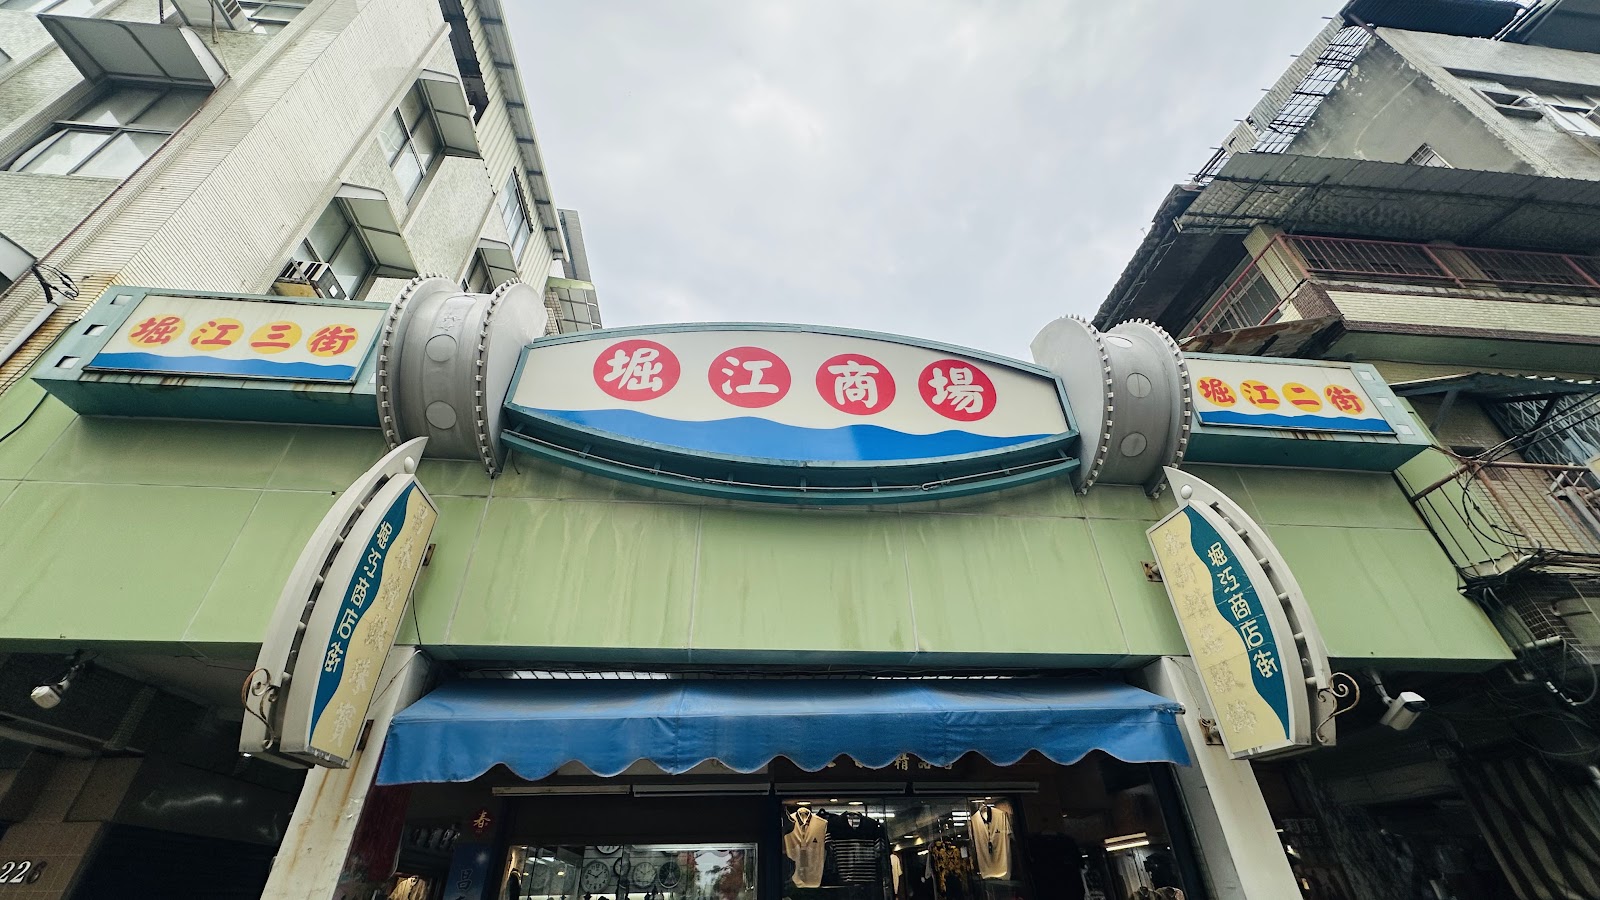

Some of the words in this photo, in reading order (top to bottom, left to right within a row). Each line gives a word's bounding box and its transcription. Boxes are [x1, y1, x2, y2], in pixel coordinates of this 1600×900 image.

[130, 316, 356, 354] 堀江三街
[603, 348, 985, 414] 堀江商場
[1199, 378, 1364, 413] 堀江二街
[1207, 542, 1279, 679] 堀江商店街
[473, 809, 492, 829] 春
